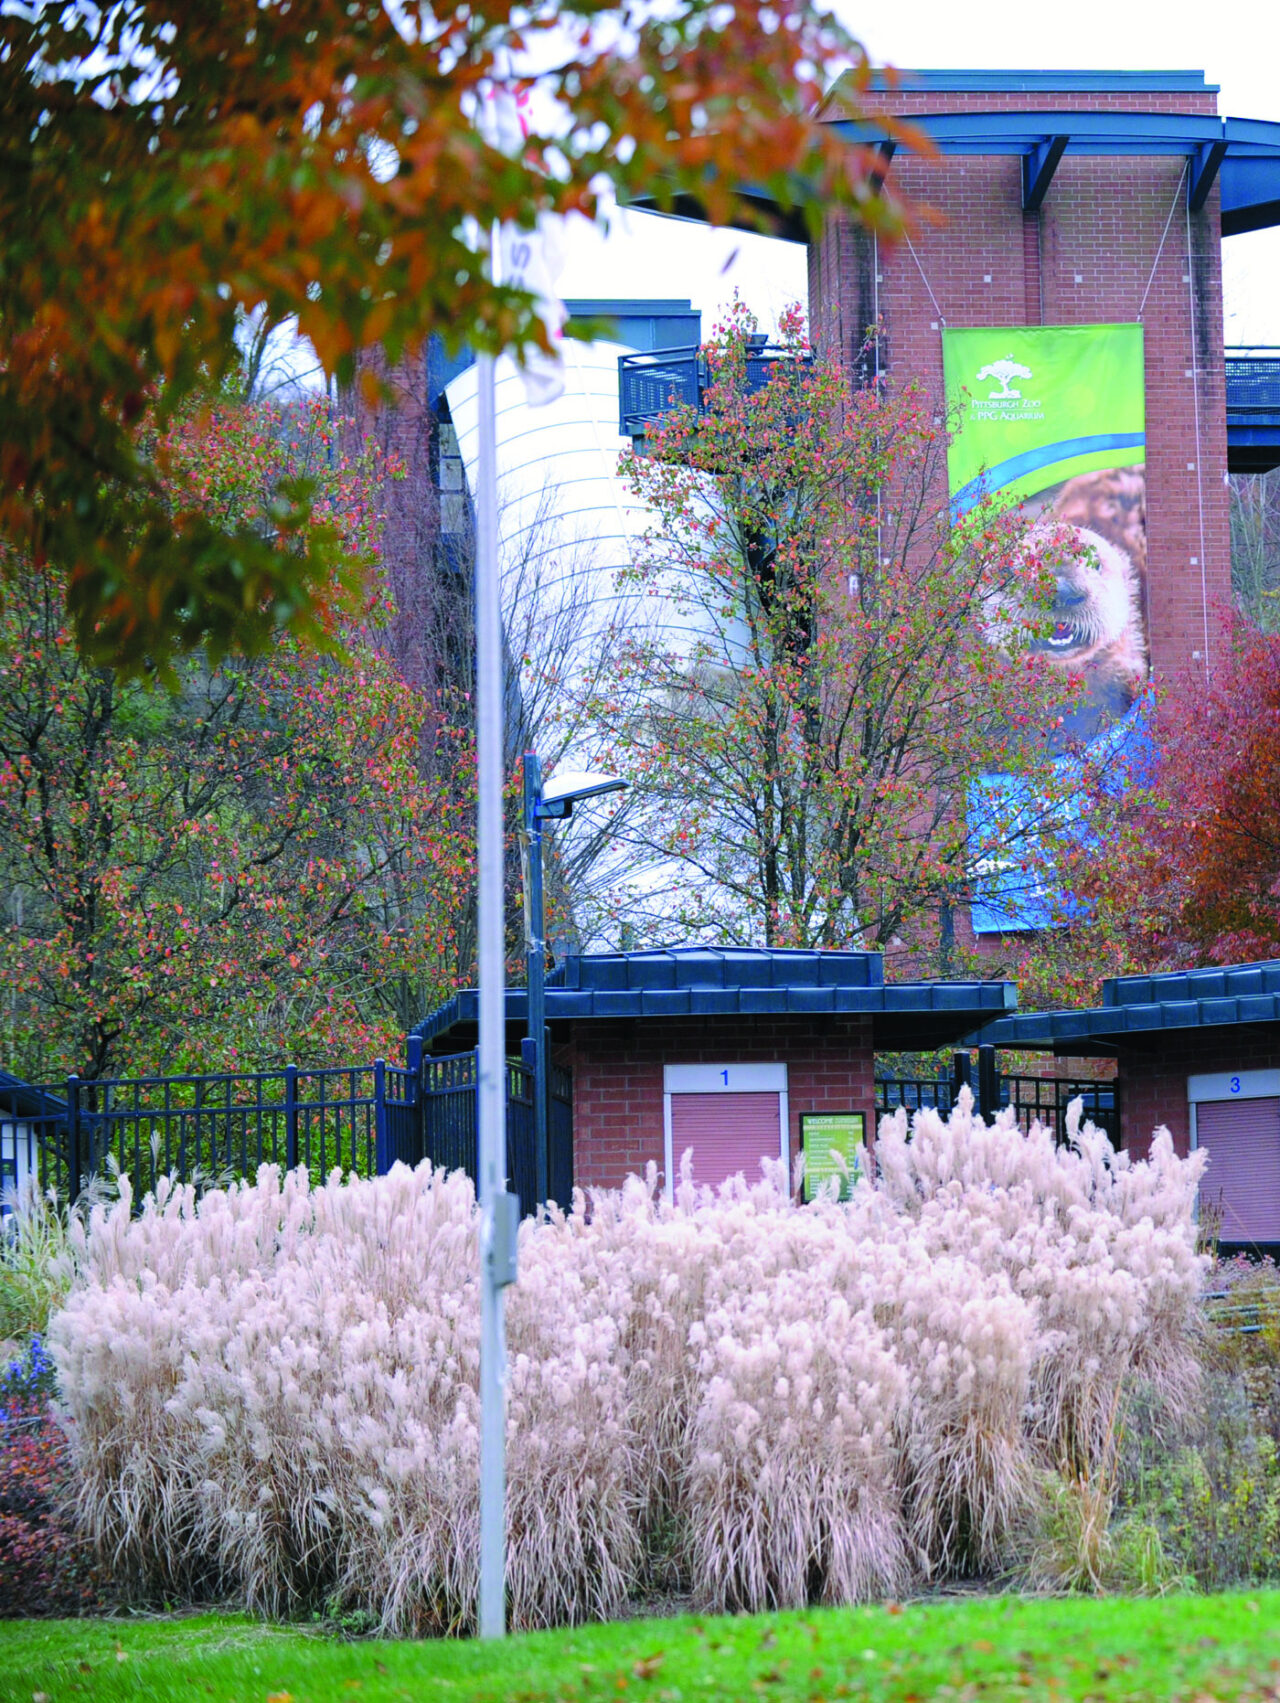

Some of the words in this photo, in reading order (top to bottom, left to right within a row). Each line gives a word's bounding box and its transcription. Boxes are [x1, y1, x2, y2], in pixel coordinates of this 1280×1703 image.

[977, 411, 998, 420] PPG
[1000, 411, 1045, 420] AQUARIUM
[720, 1069, 729, 1086] 1
[1230, 1076, 1241, 1093] 3
